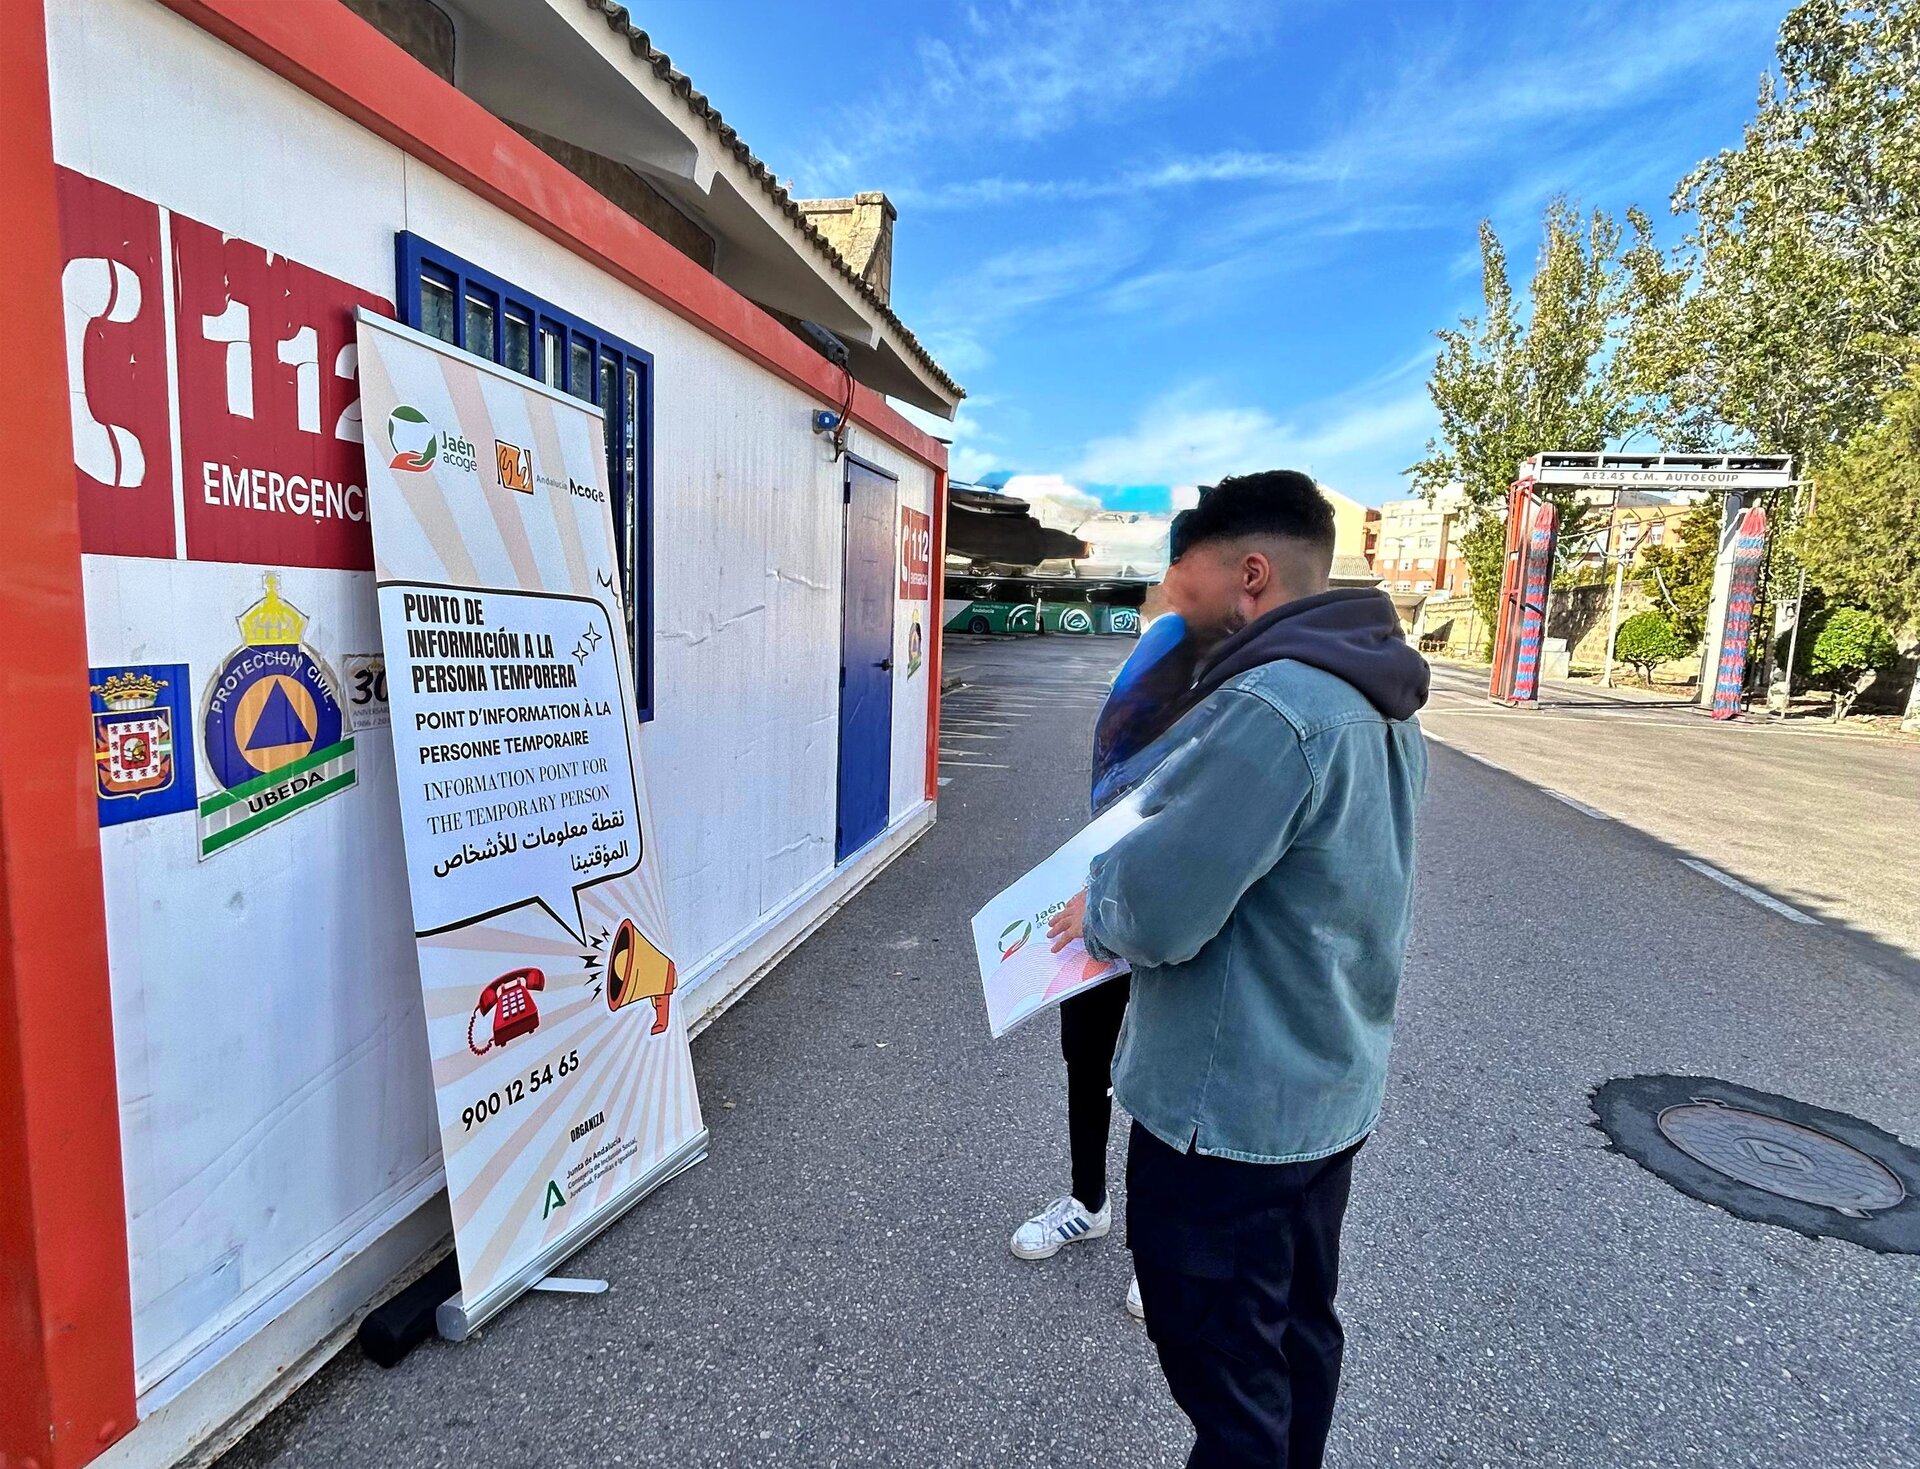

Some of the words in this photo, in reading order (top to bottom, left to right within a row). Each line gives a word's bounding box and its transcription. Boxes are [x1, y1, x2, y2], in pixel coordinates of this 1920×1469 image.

[202, 299, 364, 444] 112
[441, 430, 476, 457] Jaén
[443, 451, 478, 472] acoge
[1583, 472, 1625, 480] AE2.45
[1632, 472, 1658, 481] C.M.
[1666, 473, 1739, 482] AUTOEQUIP
[203, 461, 371, 523] EMERGENCI
[912, 528, 928, 562] 112
[403, 593, 460, 624] PUNTO
[464, 598, 484, 625] DE
[407, 626, 520, 658] INFORMACIÓN
[524, 633, 534, 658] A
[537, 633, 554, 658] LA
[307, 665, 333, 703] CIVIL
[352, 667, 388, 704] 30
[411, 665, 488, 693] PERSONA
[491, 664, 577, 691] TEMPORERA
[416, 711, 465, 731] POINT
[584, 698, 593, 717] À
[595, 701, 611, 716] LA
[419, 739, 501, 764] PERSONNE
[504, 730, 589, 754] TEMPORAIRE
[248, 772, 324, 813] UBEDA
[423, 768, 535, 801] INFORMATION
[539, 761, 579, 782] POINT
[582, 758, 608, 775] FOR
[427, 812, 463, 835] THE
[466, 794, 556, 827] TEMPORARY
[560, 784, 610, 809] PERSON
[592, 810, 625, 832] نقطة
[523, 822, 587, 849] معلومات
[434, 832, 517, 878] للأشخاص
[1035, 901, 1066, 923] Jaén
[462, 1092, 500, 1132] 900
[505, 1079, 525, 1106] 12
[530, 1064, 554, 1093] 54
[558, 1050, 579, 1077] 65
[570, 1111, 604, 1142] ORGANIZA
[567, 1162, 584, 1179] Junta
[585, 1157, 592, 1165] de
[593, 1136, 621, 1160] Andalucía
